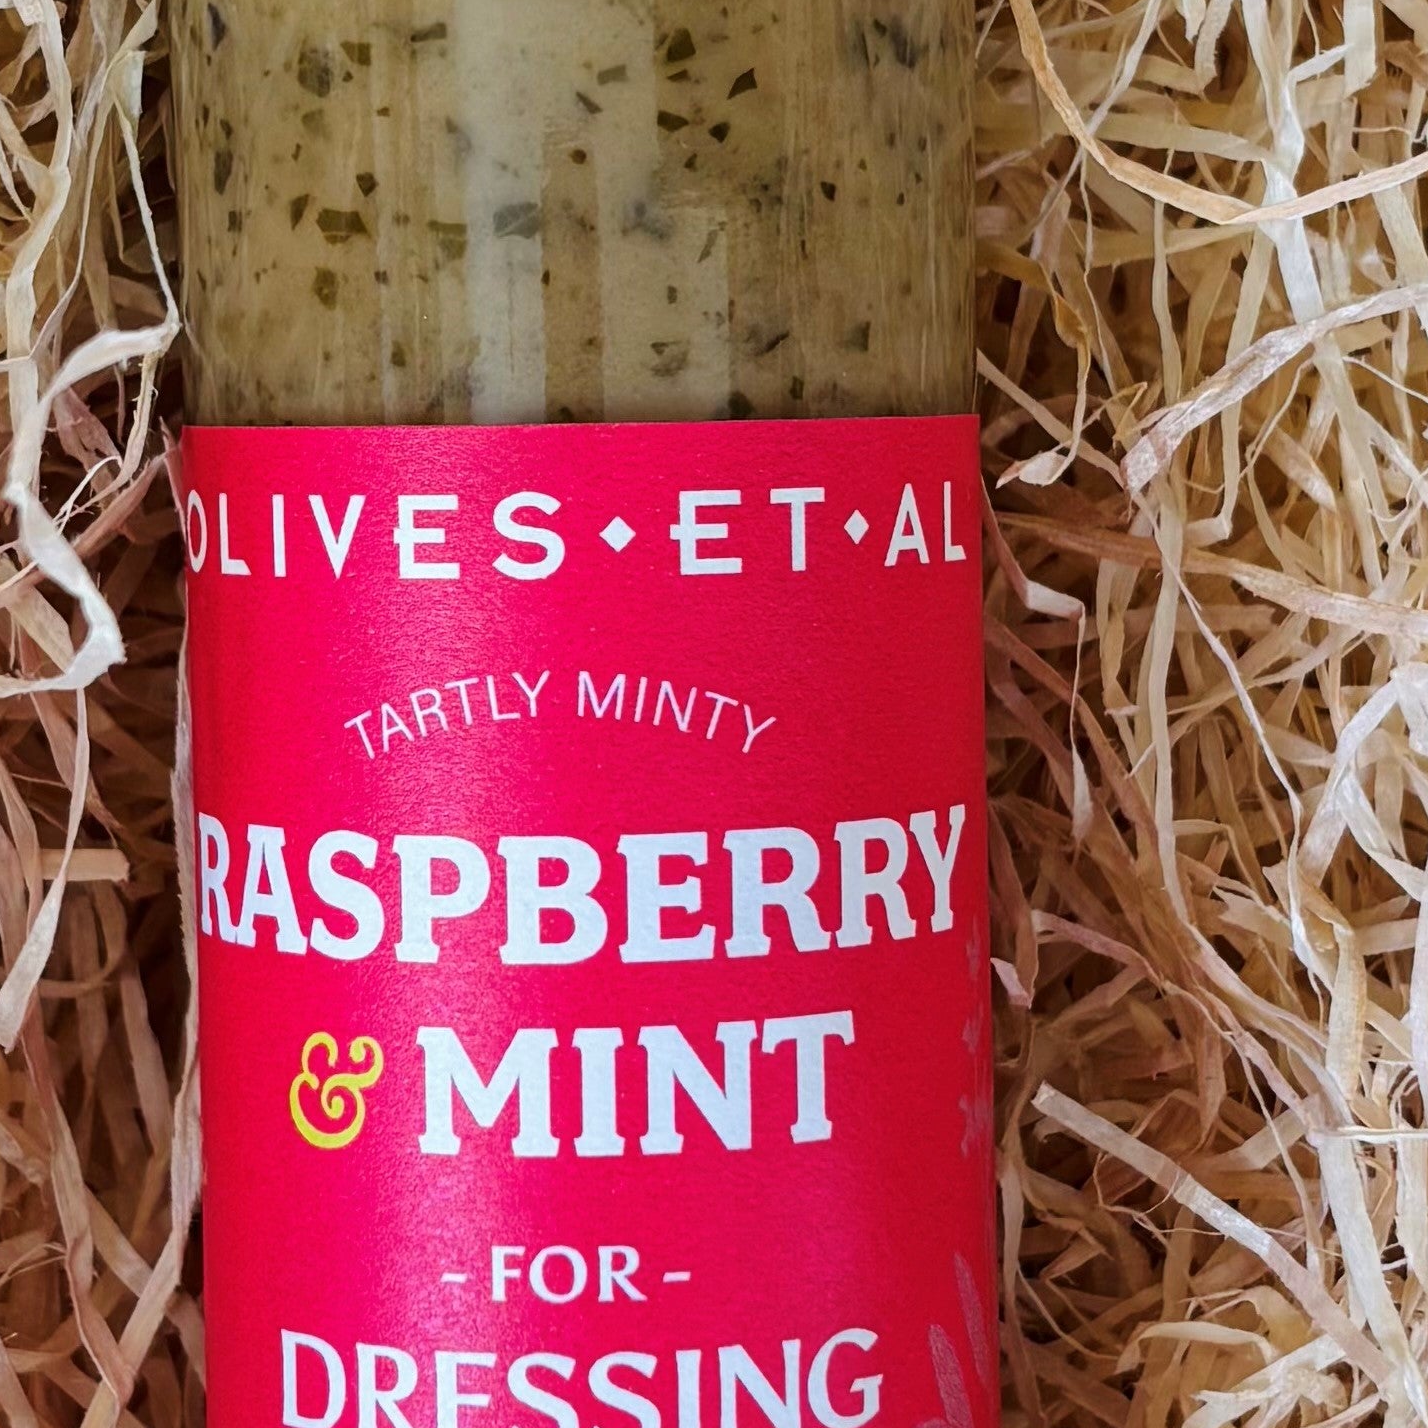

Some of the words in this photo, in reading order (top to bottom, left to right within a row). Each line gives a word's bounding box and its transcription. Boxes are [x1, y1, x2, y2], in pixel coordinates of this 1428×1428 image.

[186, 488, 567, 581] OLIVES
[670, 485, 826, 577] ET
[884, 480, 967, 568] AL
[343, 670, 551, 761] TARTLY
[576, 672, 778, 755] MINTY
[198, 803, 967, 967] RASPBERRY
[288, 1030, 384, 1151] &
[416, 1009, 856, 1160] MINT
